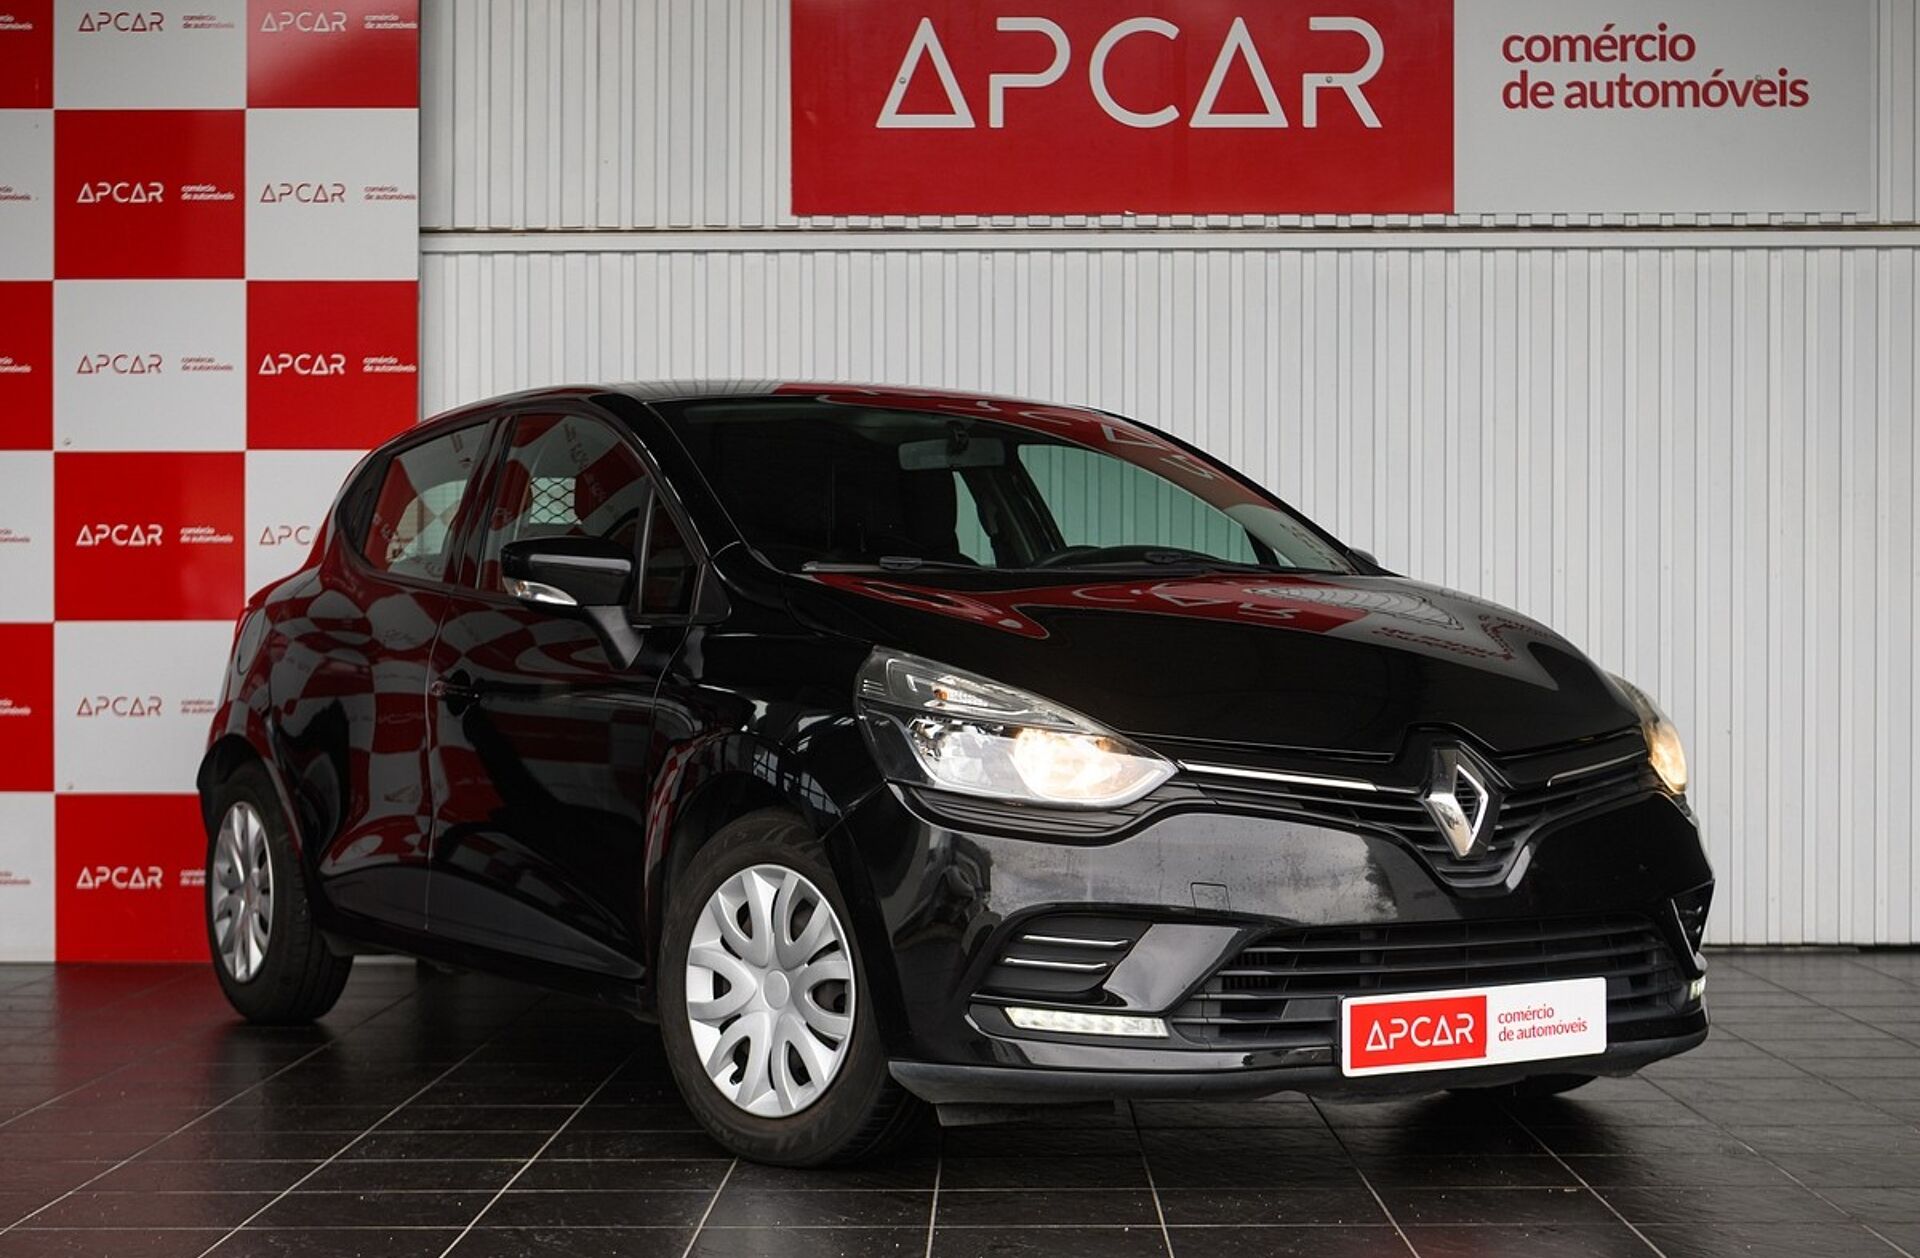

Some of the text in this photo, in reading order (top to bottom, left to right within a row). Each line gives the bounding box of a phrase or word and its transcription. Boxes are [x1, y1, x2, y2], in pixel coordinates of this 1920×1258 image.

[79, 12, 164, 32] APCAR
[261, 12, 346, 32] APCAR
[1502, 22, 1696, 63] comércio
[876, 16, 1384, 129] APCAR
[1502, 67, 1810, 109] de automóveis
[77, 182, 164, 203] APCAR
[260, 183, 346, 203] APCAR
[77, 354, 163, 374] APCAR
[259, 354, 346, 374] APCAR
[76, 524, 163, 545] APCAR
[260, 525, 319, 545] APC
[77, 696, 162, 717] APCAR
[76, 866, 163, 888] APCAR
[1497, 1003, 1555, 1024] comércio
[1365, 1013, 1475, 1052] APCAR
[1498, 1016, 1588, 1042] de automóveis
